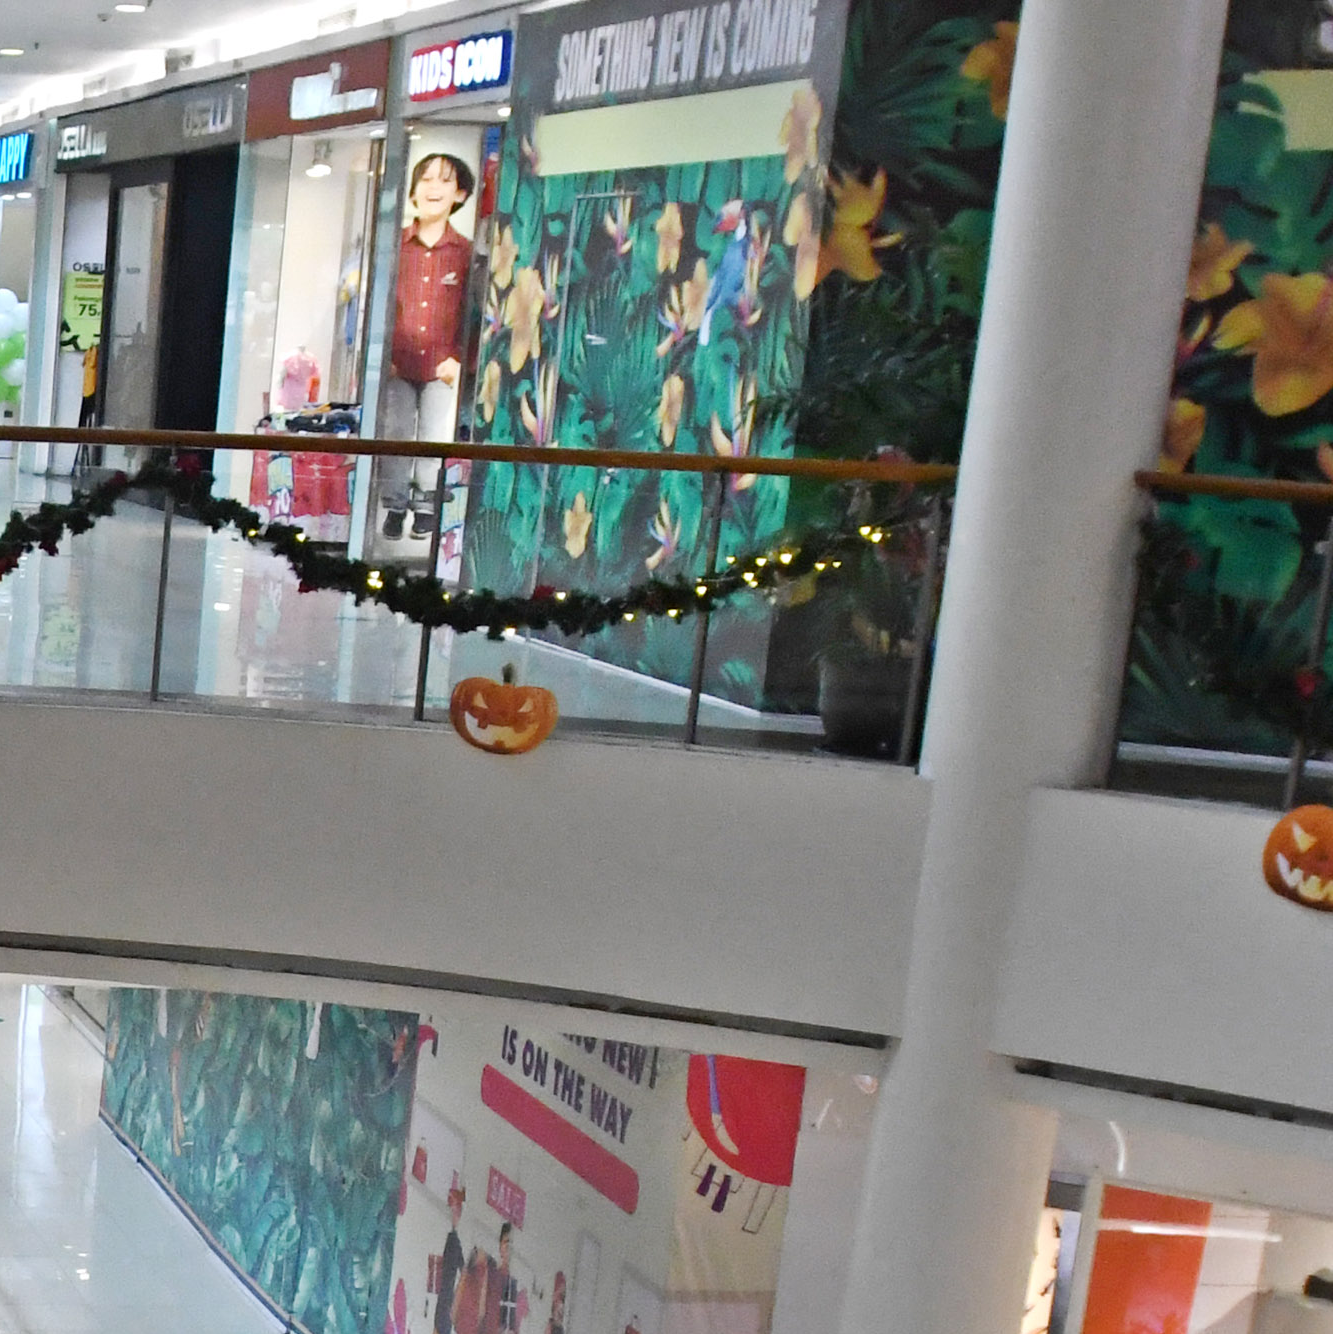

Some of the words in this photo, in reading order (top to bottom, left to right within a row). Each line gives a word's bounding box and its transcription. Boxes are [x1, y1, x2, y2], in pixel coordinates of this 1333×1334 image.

[408, 46, 454, 96] KIDS
[453, 35, 503, 88] ICON
[554, 15, 656, 102] SOMETHING
[655, 6, 708, 86] NEW
[704, 1, 732, 80] IS
[732, 0, 819, 76] COMING
[501, 1024, 518, 1066] IS
[522, 1039, 549, 1087] ON
[553, 1058, 586, 1114] THE
[589, 1083, 633, 1145] WAY
[602, 1039, 648, 1085] NEW
